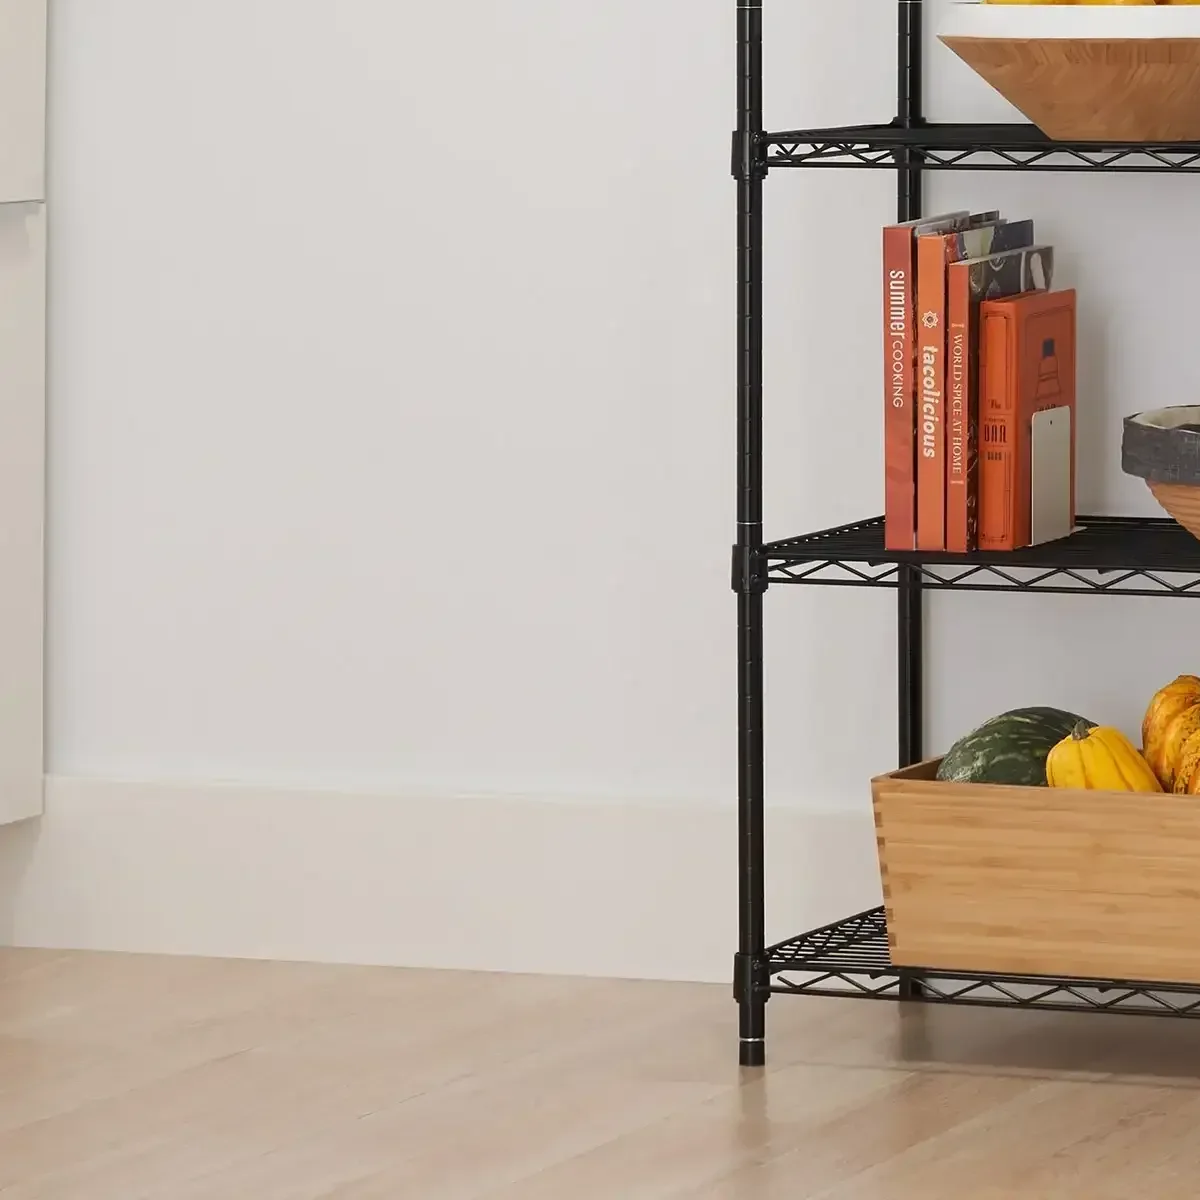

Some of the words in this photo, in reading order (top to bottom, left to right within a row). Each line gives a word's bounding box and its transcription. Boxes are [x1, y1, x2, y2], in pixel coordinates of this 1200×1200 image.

[889, 270, 905, 340] summer
[892, 340, 904, 408] COOKING
[952, 334, 964, 381] WORLD
[922, 345, 941, 458] tacolicious
[952, 383, 963, 416] SPICE
[952, 418, 962, 434] AT
[952, 437, 962, 474] HOME
